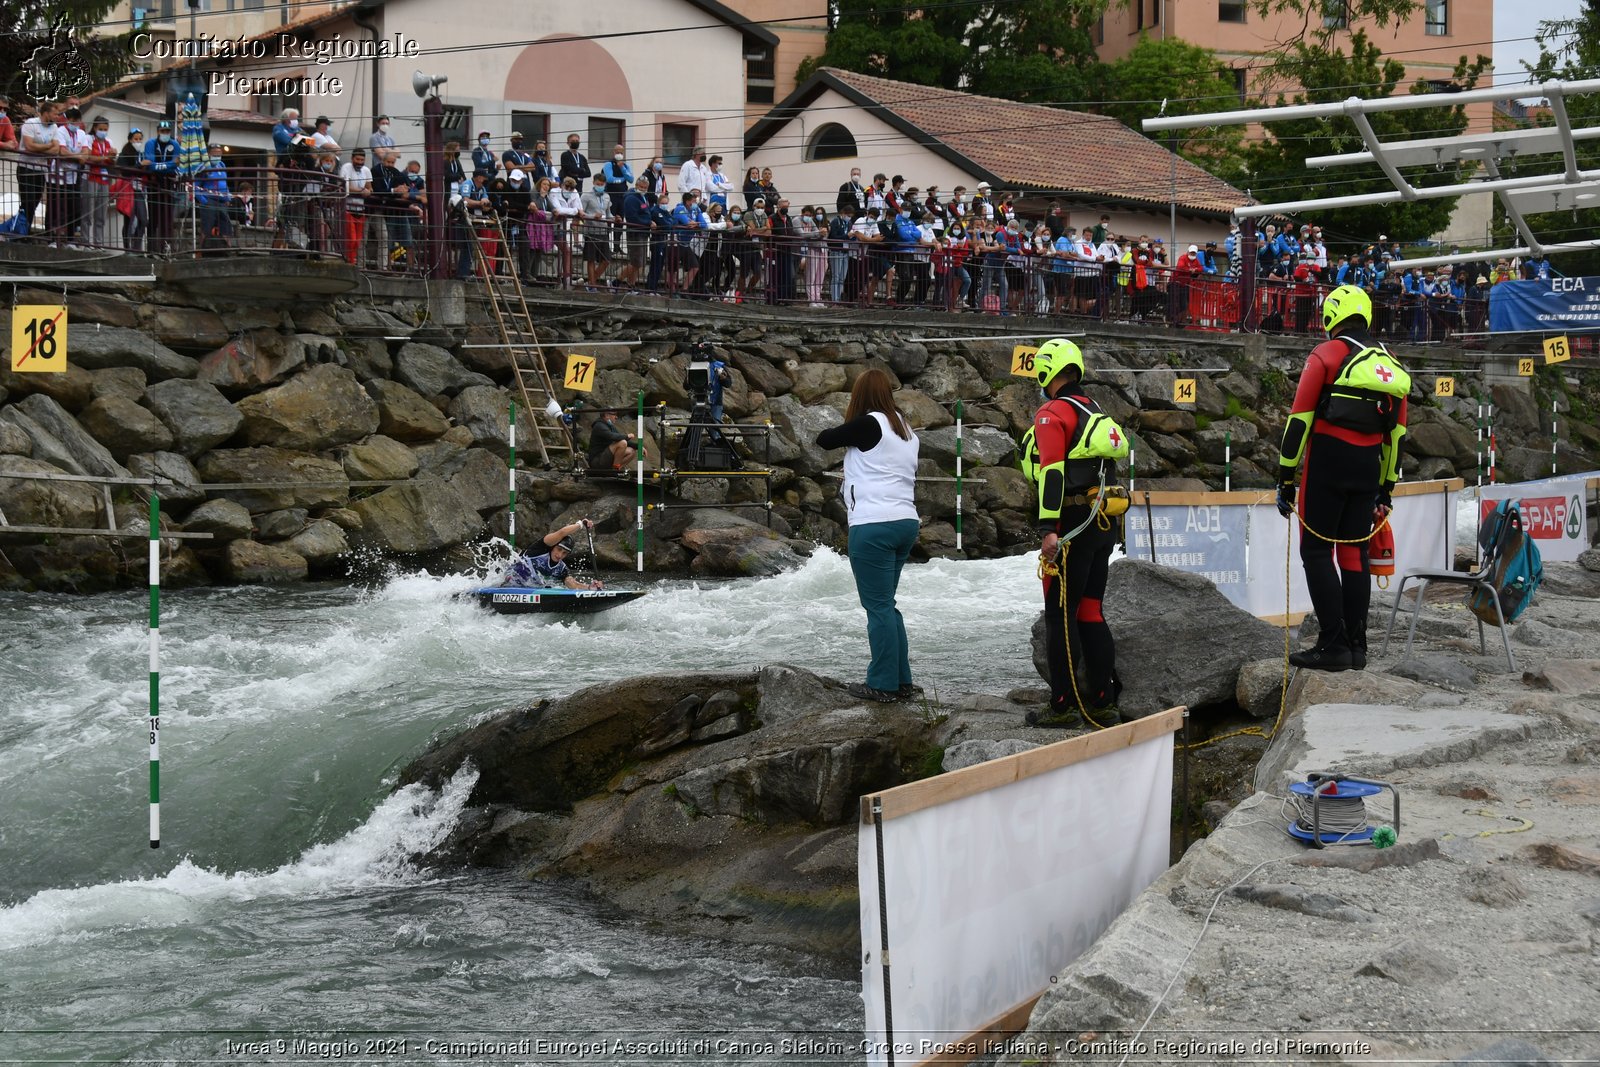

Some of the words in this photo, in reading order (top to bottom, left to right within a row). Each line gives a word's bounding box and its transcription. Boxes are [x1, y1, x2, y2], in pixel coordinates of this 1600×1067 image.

[1552, 277, 1585, 292] ECA
[24, 318, 57, 360] 18
[1549, 341, 1565, 358] 15
[1018, 352, 1035, 372] 16
[1521, 362, 1531, 373] 12
[572, 361, 591, 384] 17
[1178, 383, 1192, 398] 14
[1439, 381, 1451, 393] 13
[493, 594, 521, 603] MICOZZI
